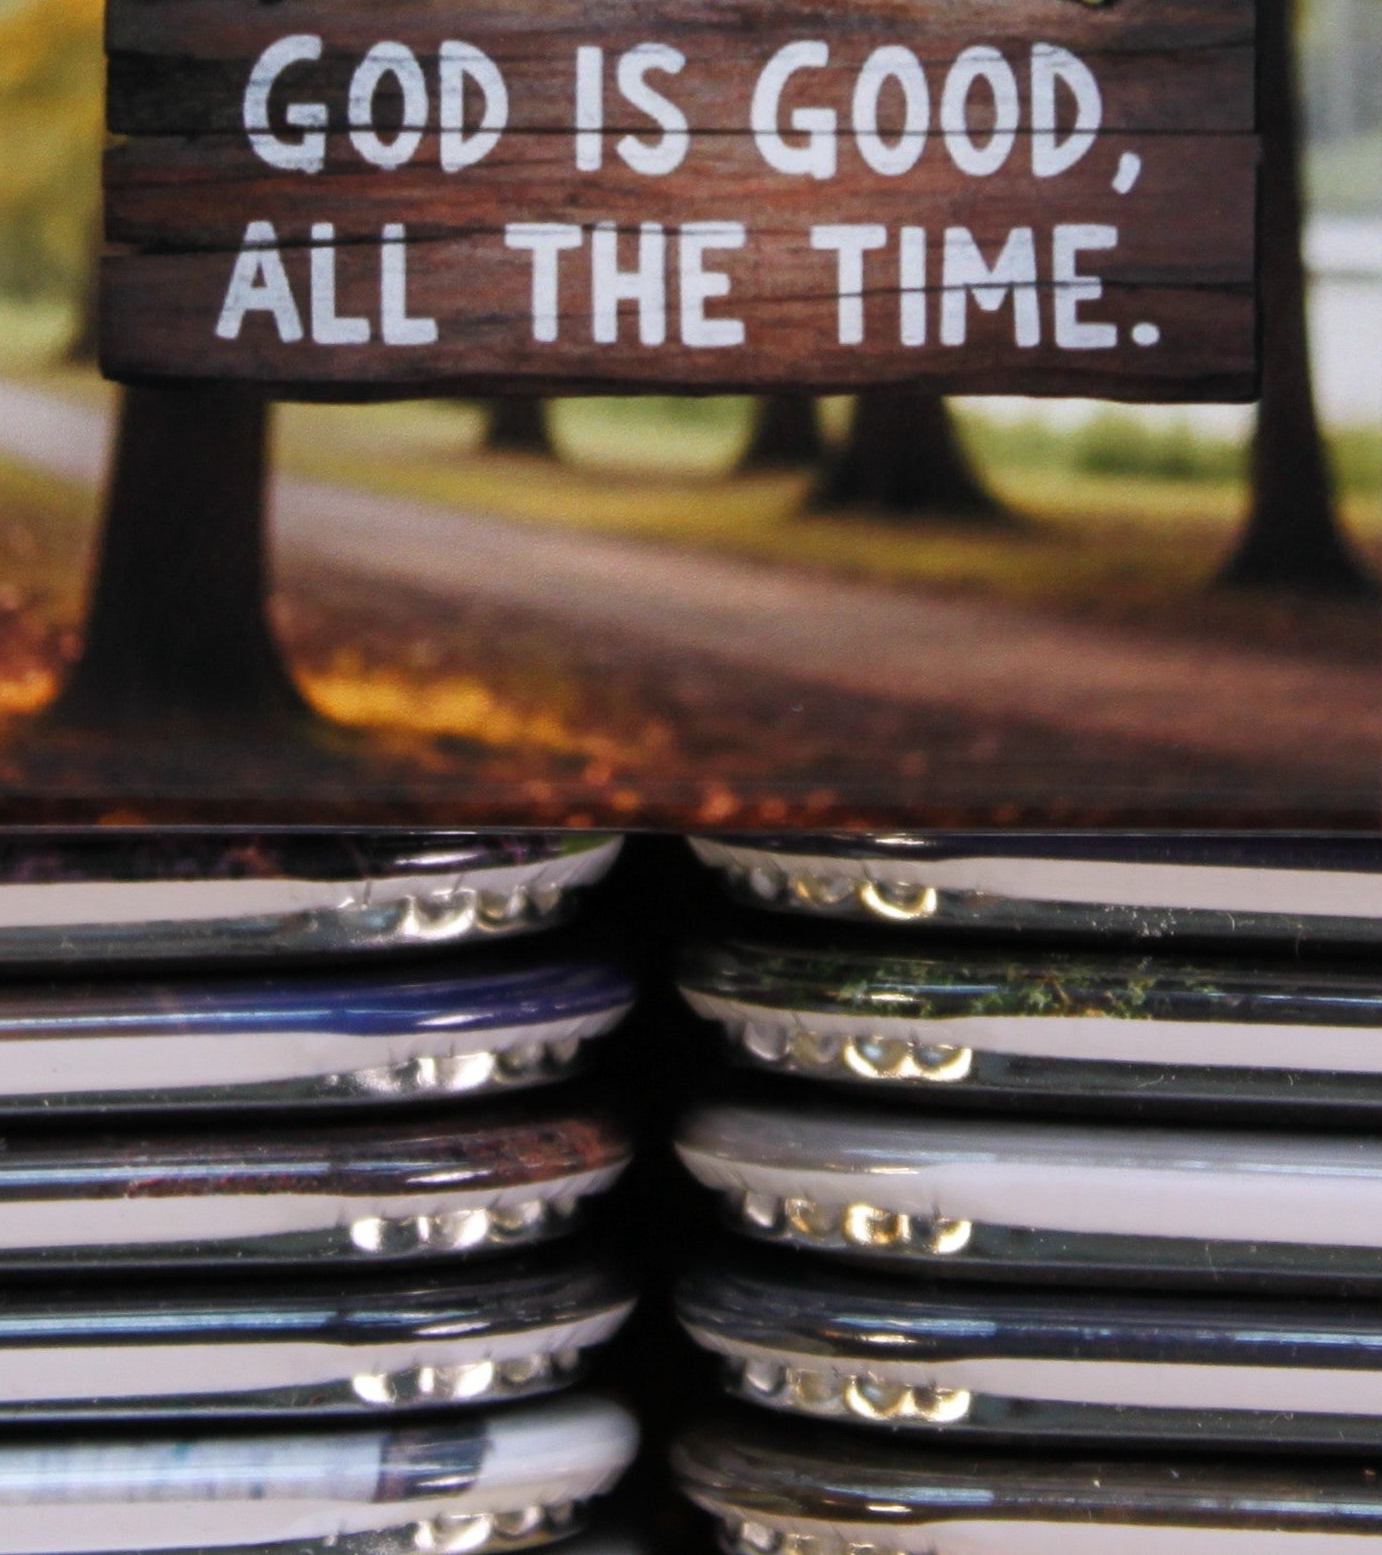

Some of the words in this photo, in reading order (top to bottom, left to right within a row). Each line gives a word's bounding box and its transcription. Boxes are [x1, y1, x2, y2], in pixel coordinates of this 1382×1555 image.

[242, 33, 510, 175] GOD
[575, 41, 689, 177] IS
[750, 39, 1143, 196] GOOD,
[215, 220, 439, 347] ALL
[505, 222, 746, 348] THE
[811, 222, 1160, 351] TIME.
